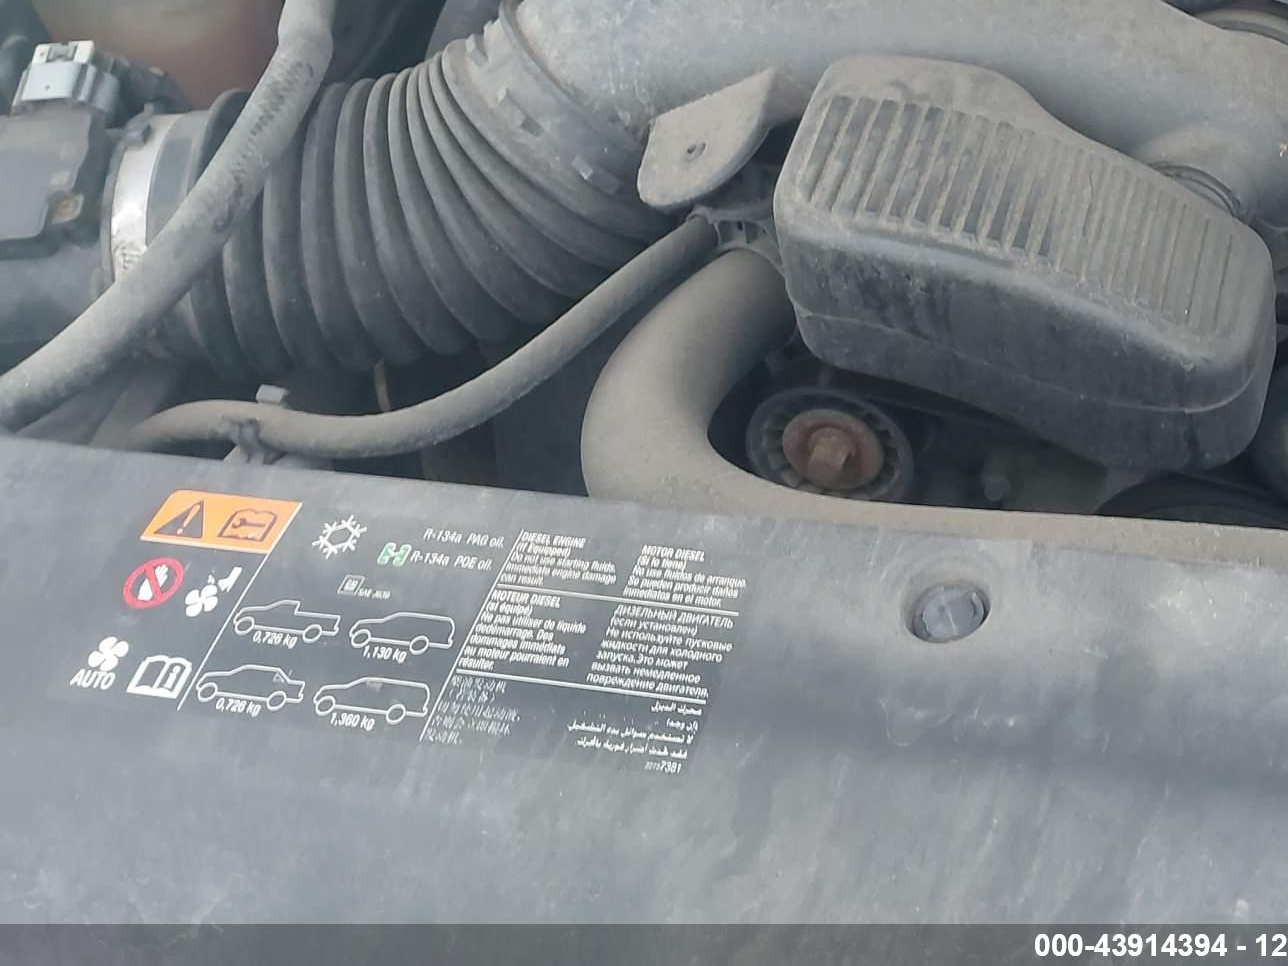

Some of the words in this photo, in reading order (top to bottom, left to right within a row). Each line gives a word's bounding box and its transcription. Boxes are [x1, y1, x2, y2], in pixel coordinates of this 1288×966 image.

[522, 531, 551, 545] DIESEL
[553, 535, 586, 549] ENGINE
[410, 550, 450, 566] R-134a
[454, 555, 478, 569] POE
[641, 544, 674, 556] MOTOR
[675, 548, 705, 562] DIESEL
[524, 553, 540, 564] not
[540, 556, 556, 566] use
[556, 557, 590, 571] starting
[551, 568, 581, 580] engine
[581, 571, 617, 585] damage
[640, 578, 673, 591] pueden
[674, 581, 711, 595] producir
[491, 590, 529, 604] MOTEUR
[530, 594, 561, 608] DIESEL
[671, 593, 683, 603] en
[494, 614, 511, 625] pas
[543, 619, 556, 630] de
[614, 604, 678, 622] ДИЗЕЛЬНЫЙ
[678, 612, 735, 629] ДВИГАТЕЛЬ
[282, 634, 298, 649] kg
[470, 634, 518, 650] dommages
[606, 626, 620, 638] Не
[685, 638, 733, 652] пусковые
[392, 648, 407, 664] kg
[464, 645, 476, 656] au
[477, 647, 510, 661] moteur
[510, 651, 557, 666] pourraient
[557, 657, 570, 668] en
[649, 644, 669, 655] для
[670, 647, 723, 663] холодного
[591, 662, 631, 675] вызвать
[655, 658, 688, 670] может
[69, 668, 116, 690] AUTO
[246, 701, 262, 718] kg
[360, 717, 375, 732] kg
